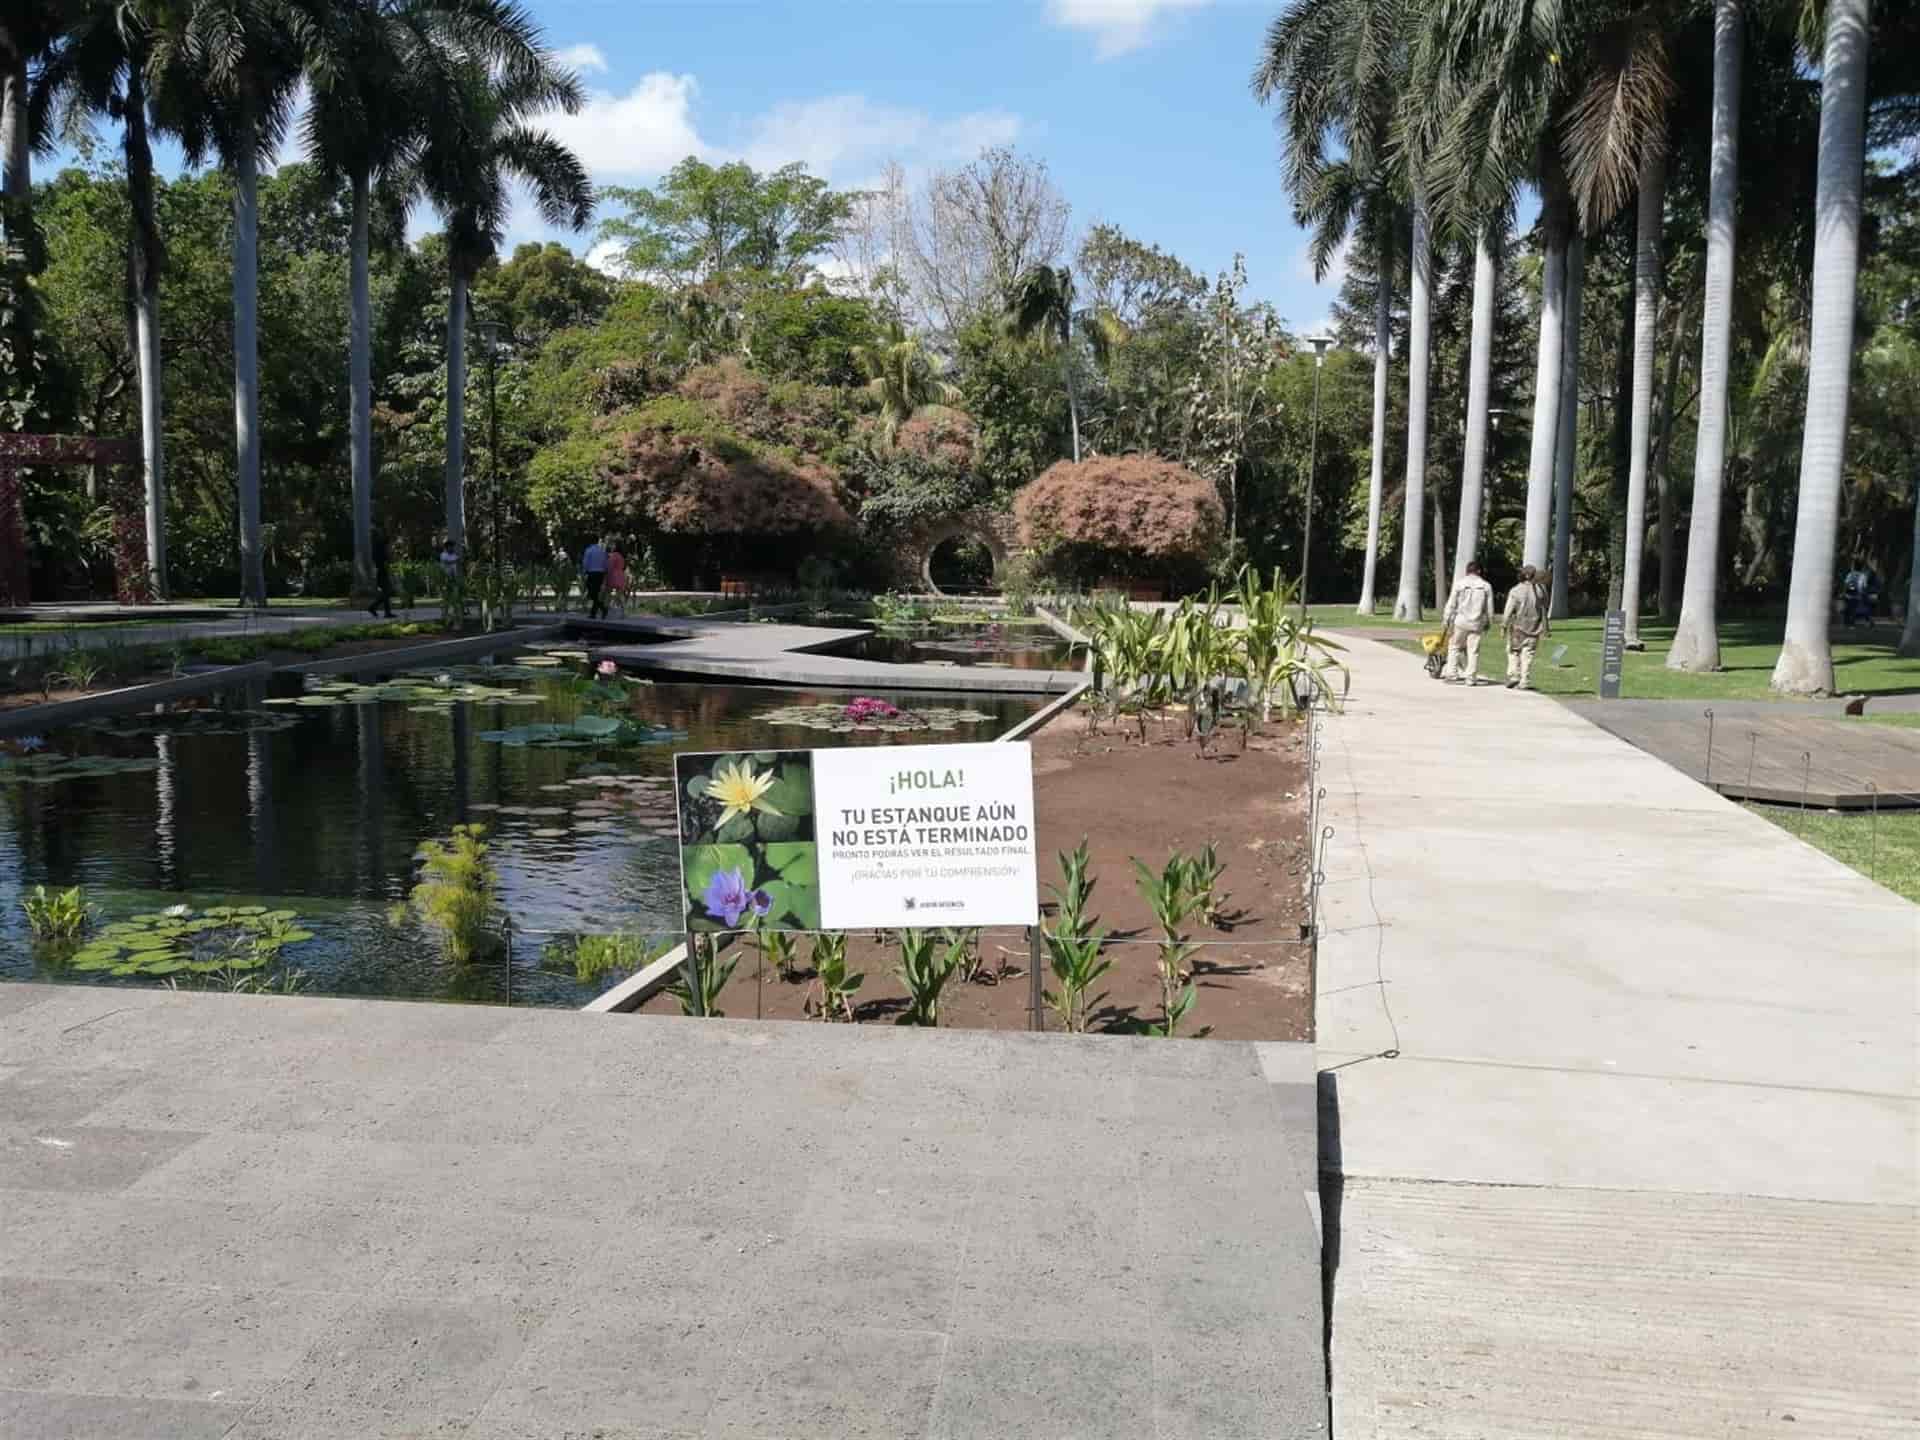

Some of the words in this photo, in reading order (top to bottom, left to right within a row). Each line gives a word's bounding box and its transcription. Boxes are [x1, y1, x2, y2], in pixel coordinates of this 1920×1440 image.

[890, 769, 964, 794] ¡HOLA!
[842, 809, 865, 825] TU
[872, 806, 970, 824] ESTANQUE
[976, 800, 1015, 821] AÚN
[832, 830, 858, 846] NO
[864, 824, 911, 845] ESTÁ
[916, 825, 1028, 843] TERMINADO
[944, 846, 1000, 856] RESULTADO
